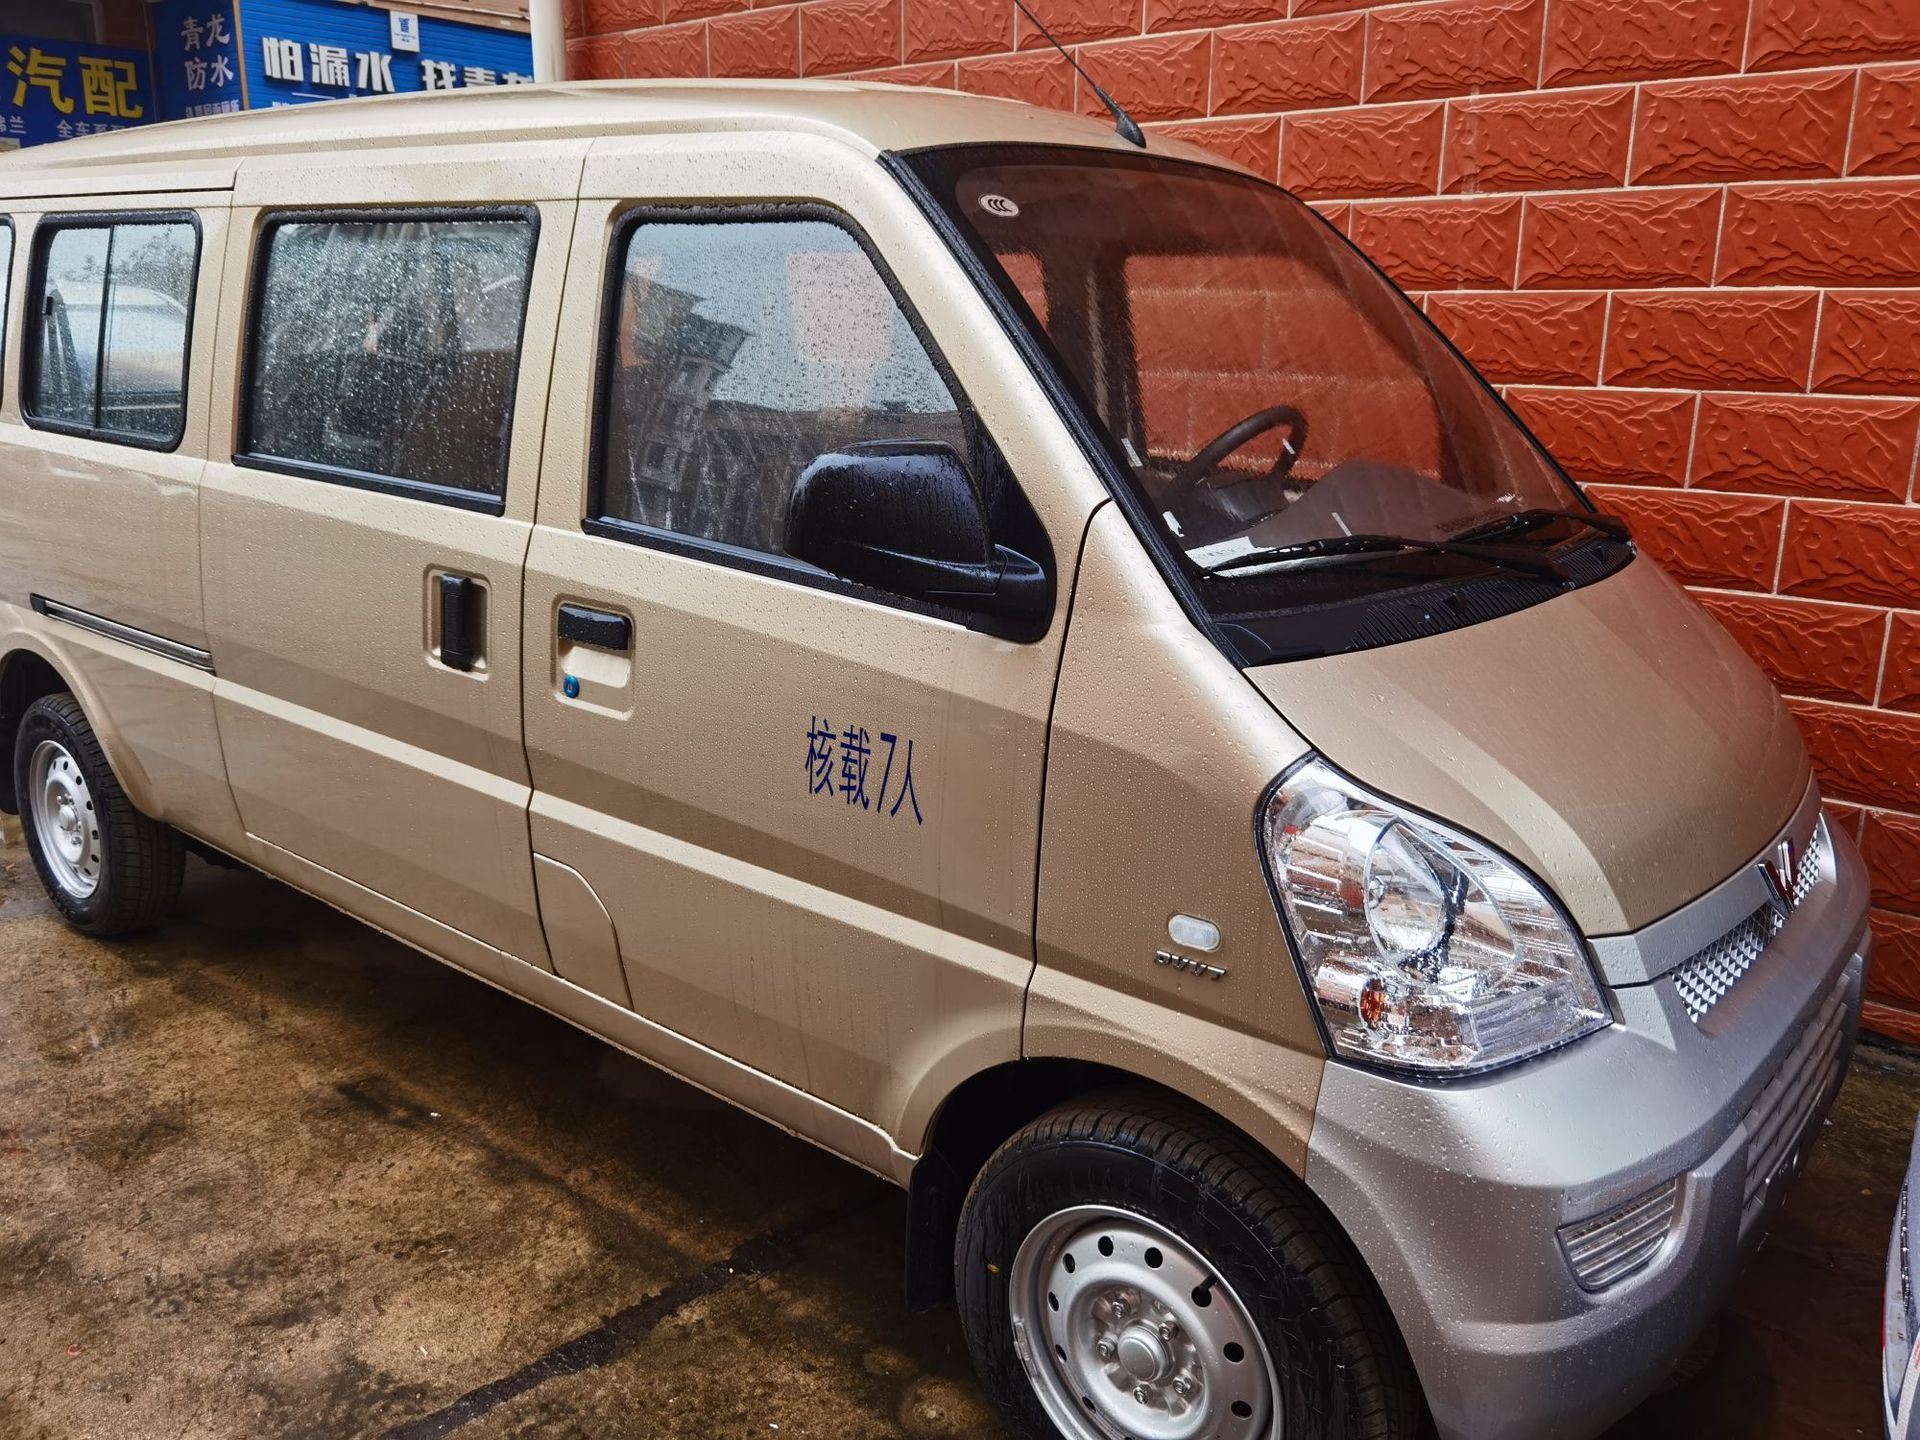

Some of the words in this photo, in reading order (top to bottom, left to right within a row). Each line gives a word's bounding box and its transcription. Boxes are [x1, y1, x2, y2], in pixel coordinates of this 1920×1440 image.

[181, 14, 230, 52] 青龙
[6, 45, 144, 119] 汽配
[184, 55, 235, 91] 防水
[262, 36, 396, 93] 怕漏水
[804, 715, 923, 826] 核载7人
